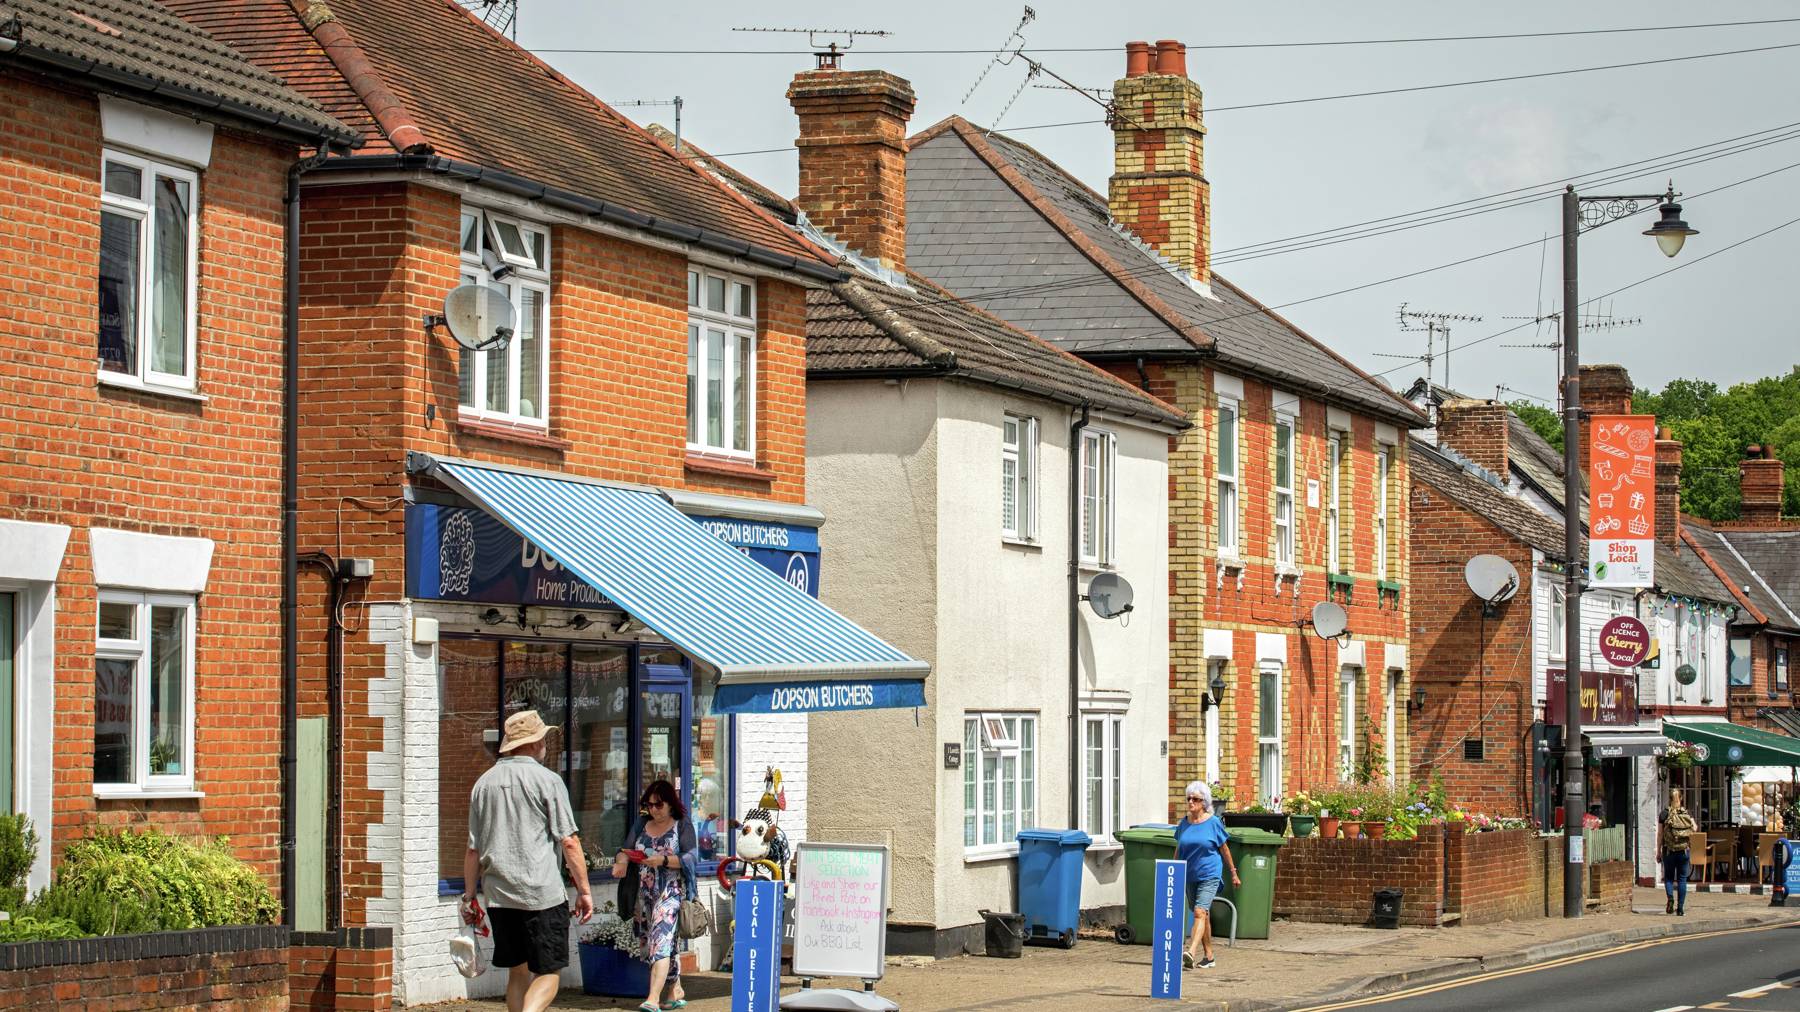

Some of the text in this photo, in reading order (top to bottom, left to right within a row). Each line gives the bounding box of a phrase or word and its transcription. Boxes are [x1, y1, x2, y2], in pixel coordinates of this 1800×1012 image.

[742, 525, 789, 547] BUTCHERS
[1608, 542, 1637, 554] Shop
[1608, 553, 1638, 563] Local
[536, 578, 567, 601] Home
[1612, 628, 1641, 637] LICENCE
[1620, 622, 1634, 630] OFF
[1605, 635, 1643, 655] Cherry
[1610, 651, 1636, 662] Local
[771, 685, 874, 710] DOPSON BUTCHERS
[1579, 674, 1617, 722] herry Local
[751, 885, 759, 938] LOCAL
[1163, 865, 1175, 994] ORDER ONLINE
[820, 934, 843, 948] BBQ
